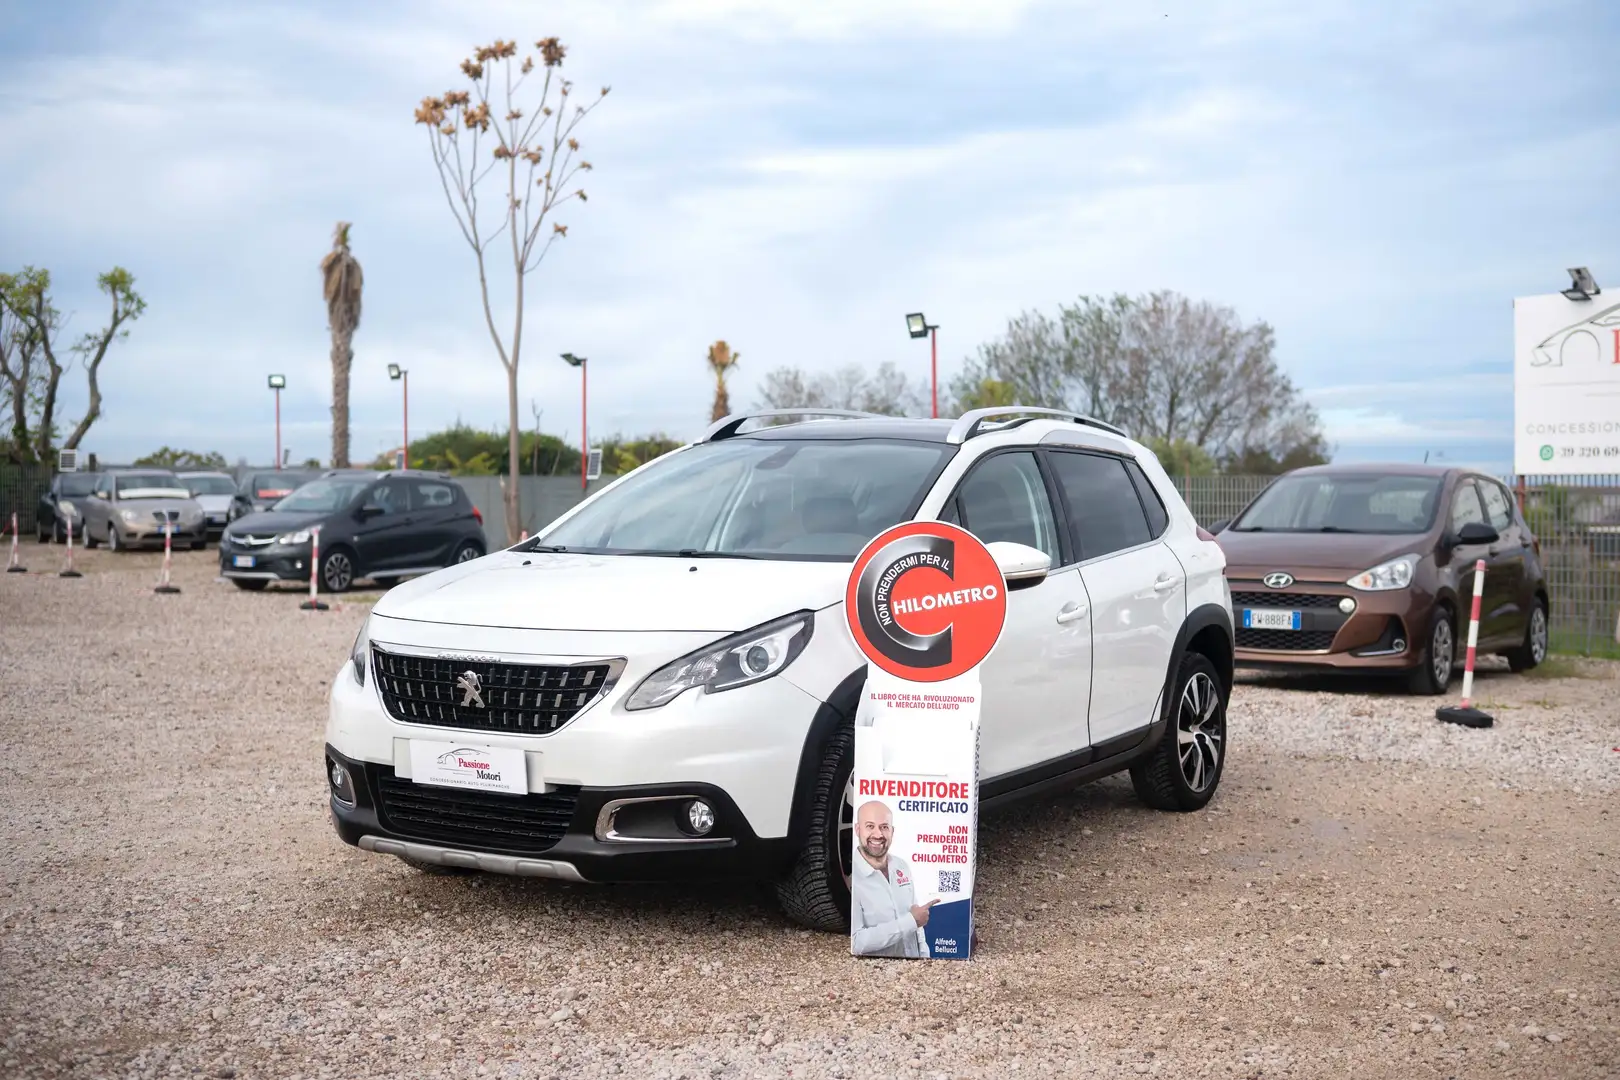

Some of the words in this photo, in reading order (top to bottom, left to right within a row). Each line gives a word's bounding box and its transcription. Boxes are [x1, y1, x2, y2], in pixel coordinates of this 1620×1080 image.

[1604, 446, 1620, 457] 69
[920, 554, 941, 566] PER
[941, 558, 950, 570] IL
[877, 556, 918, 601] PRENDERMI
[877, 603, 892, 626] NON
[878, 693, 897, 701] LIBRO
[923, 694, 975, 703] RIVOLUZIONATO
[895, 701, 926, 709] MERCATO
[927, 702, 960, 710] DELL'AUTO
[458, 758, 490, 770] Passione
[476, 770, 501, 781] Motori
[859, 778, 969, 799] RIVENDITORE
[898, 799, 969, 814] CERTIFICATO
[948, 825, 968, 835] NON
[917, 834, 968, 844] PRENDERMI
[942, 844, 959, 854] PER
[960, 845, 968, 854] IL
[912, 853, 968, 864] CHILOMETRO
[934, 937, 957, 946] Alfredo
[934, 945, 958, 954] Bellucci
